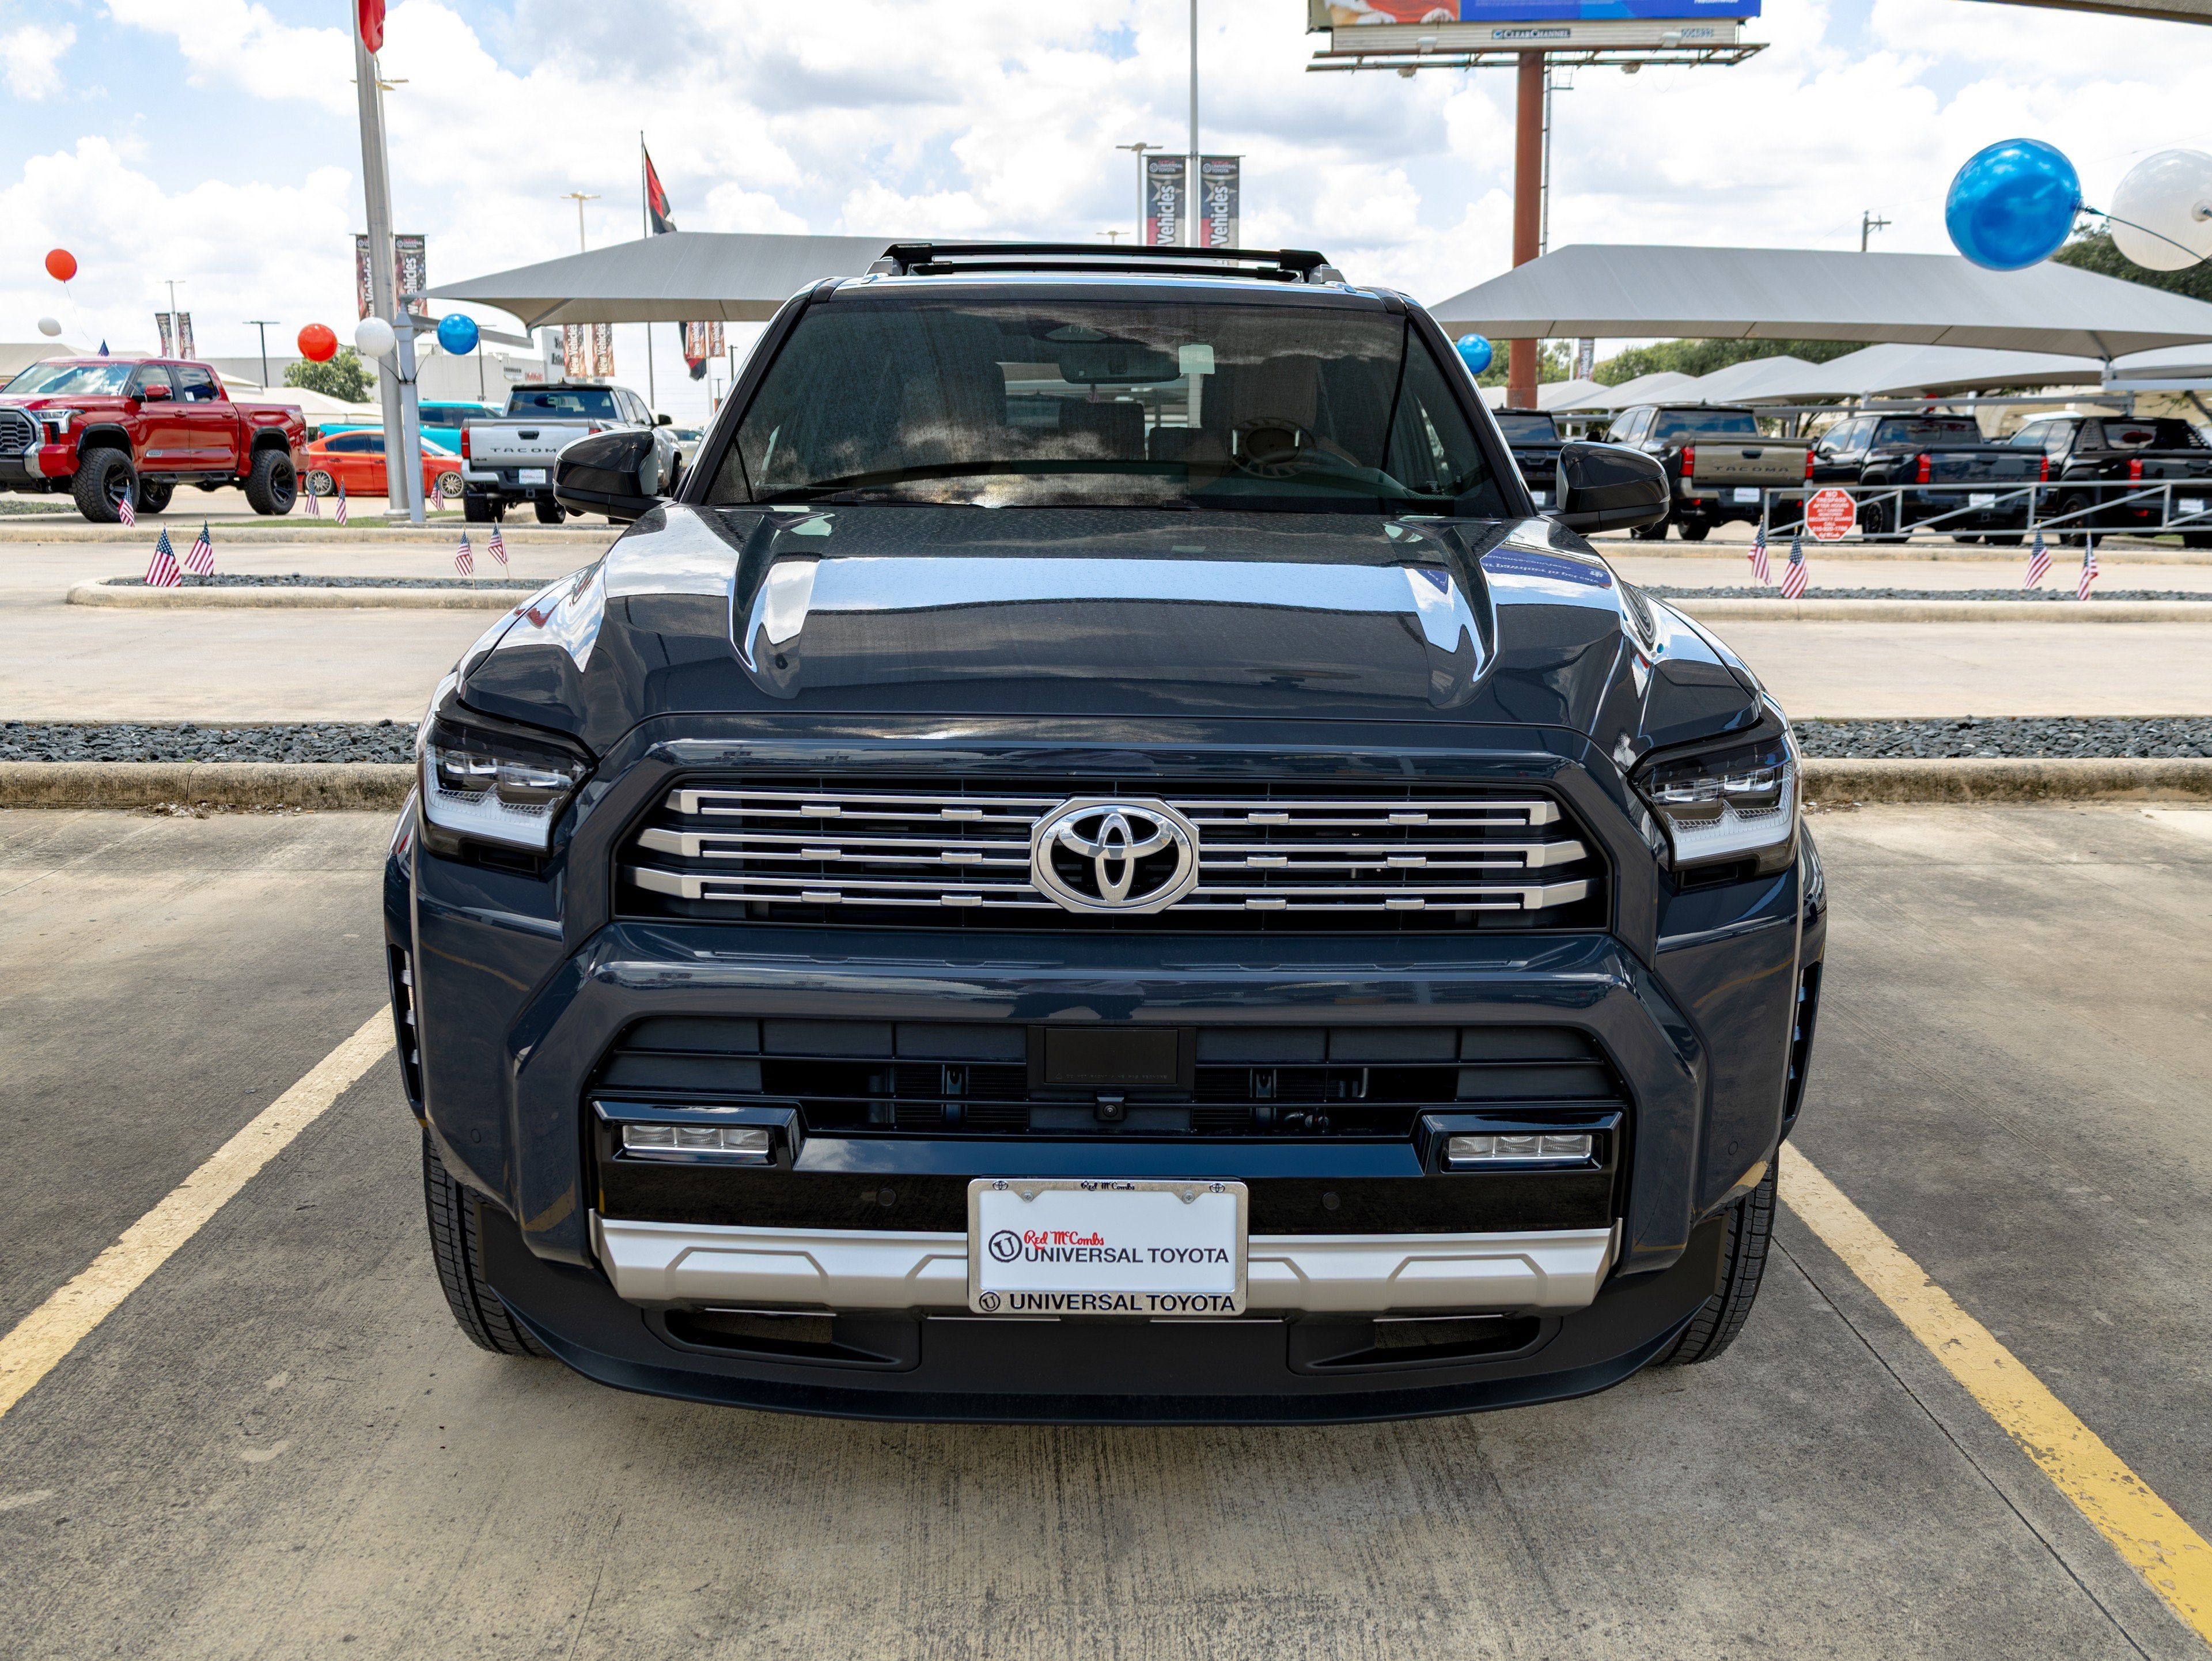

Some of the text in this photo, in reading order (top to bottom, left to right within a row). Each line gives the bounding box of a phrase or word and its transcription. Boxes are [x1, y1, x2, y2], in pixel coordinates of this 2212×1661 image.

[1157, 186, 1175, 245] Vehicles
[1210, 186, 1228, 245] Vehicles
[403, 258, 418, 294] ehicles
[567, 324, 578, 356] Vehicles
[596, 323, 606, 356] Vehicles
[691, 321, 700, 343] Vehicle
[711, 321, 719, 342] Vehicle
[570, 357, 579, 374] New
[598, 357, 608, 374] New
[1081, 1181, 1098, 1191] Red
[1024, 1229, 1048, 1251] Red
[1025, 1247, 1229, 1263] UNIVERSAL TOYOTA
[1010, 1293, 1143, 1311] UNIVERSAL
[1146, 1294, 1236, 1311] TOYOTA
